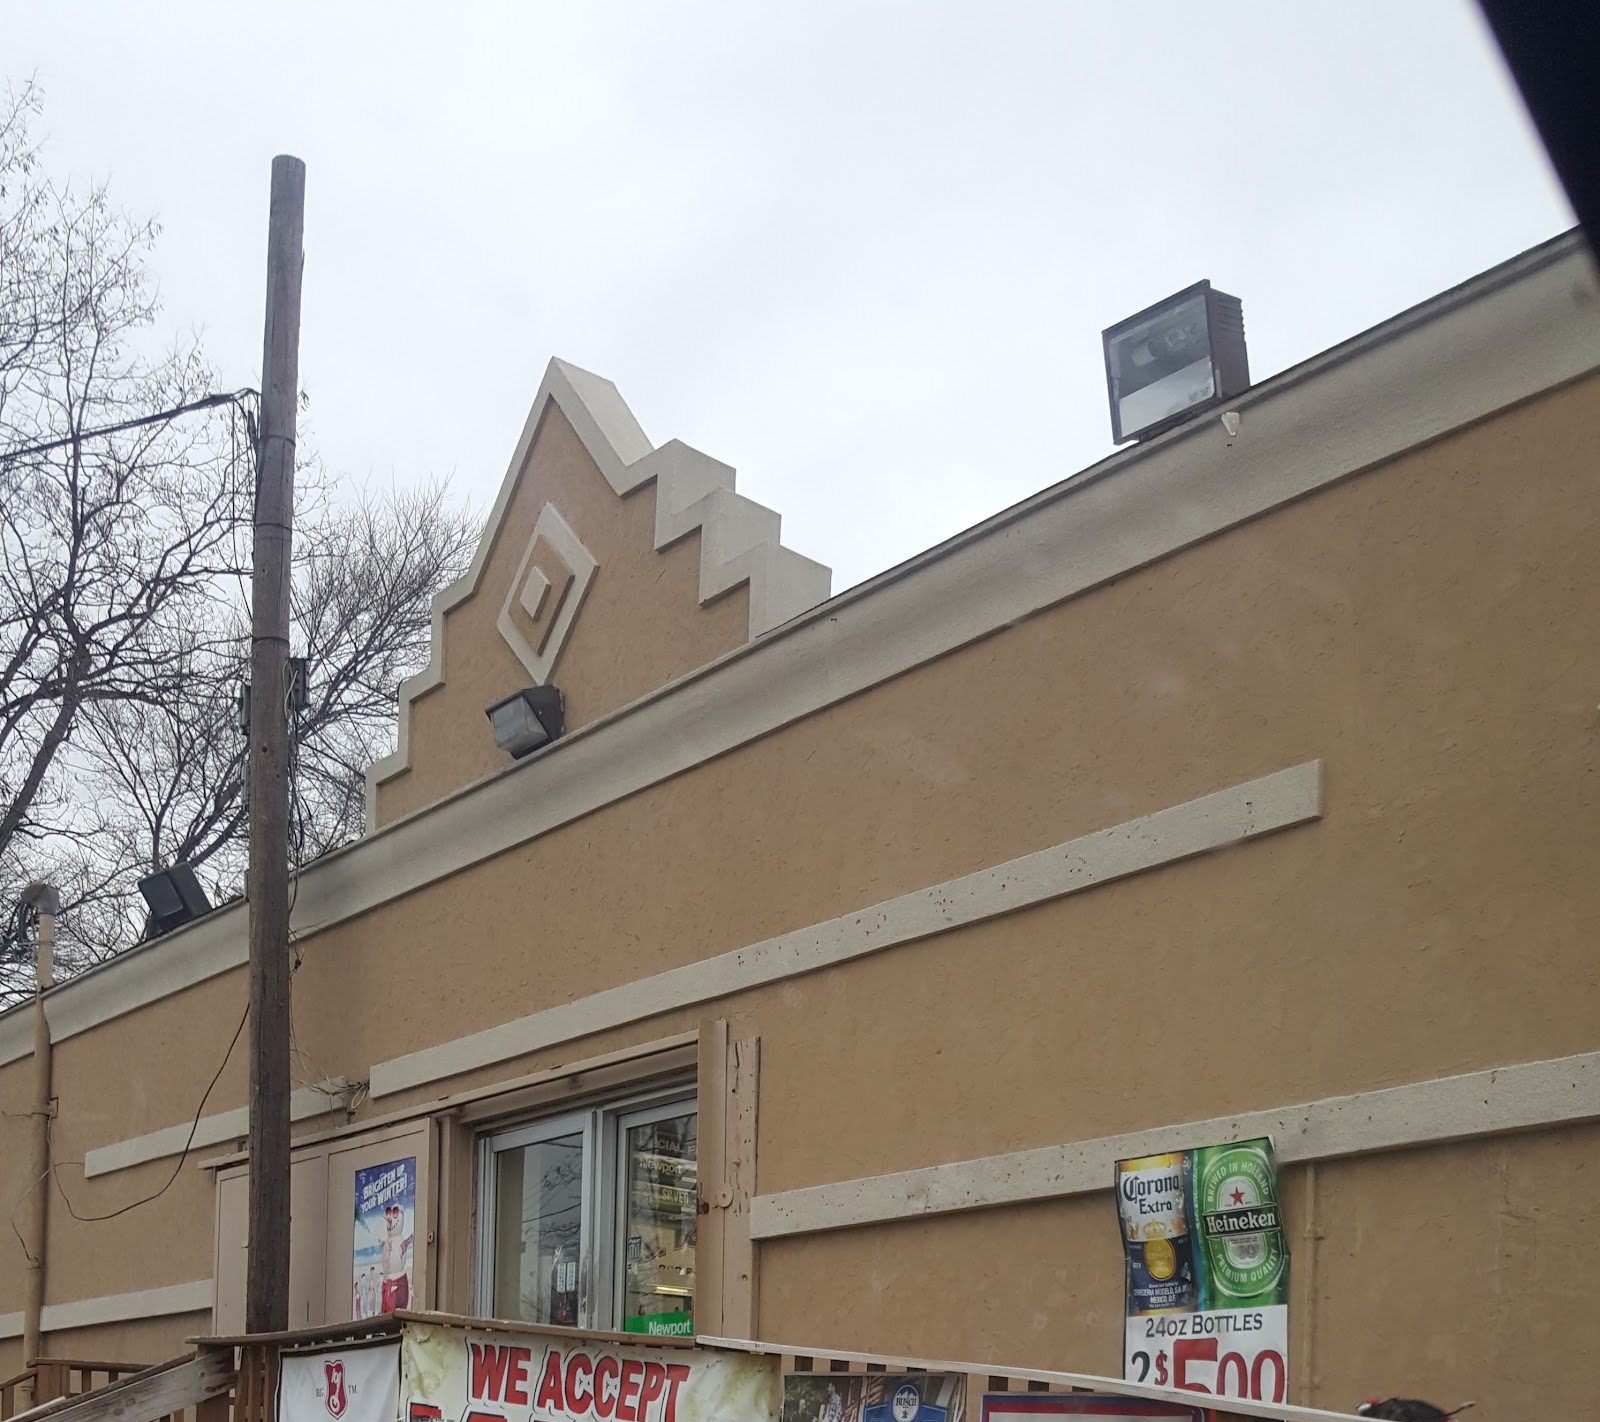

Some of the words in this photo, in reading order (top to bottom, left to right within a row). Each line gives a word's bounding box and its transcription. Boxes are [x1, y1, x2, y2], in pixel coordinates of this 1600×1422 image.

[361, 1197, 377, 1213] YOUR
[377, 1172, 408, 1206] WINTER!
[363, 1168, 395, 1200] BRIGHTEN
[397, 1164, 405, 1177] UP
[1123, 1174, 1180, 1204] Corona
[1208, 1166, 1226, 1202] BREWED
[1229, 1162, 1238, 1172] IN
[1241, 1161, 1269, 1196] HOLLAND
[1139, 1198, 1173, 1215] Extra
[1206, 1211, 1276, 1234] Heineken
[1216, 1254, 1247, 1284] PREMIUM
[1250, 1249, 1278, 1281] QUALITY
[649, 1321, 691, 1336] Newport
[1192, 1313, 1263, 1335] BOTTLES
[470, 1342, 533, 1405] WE
